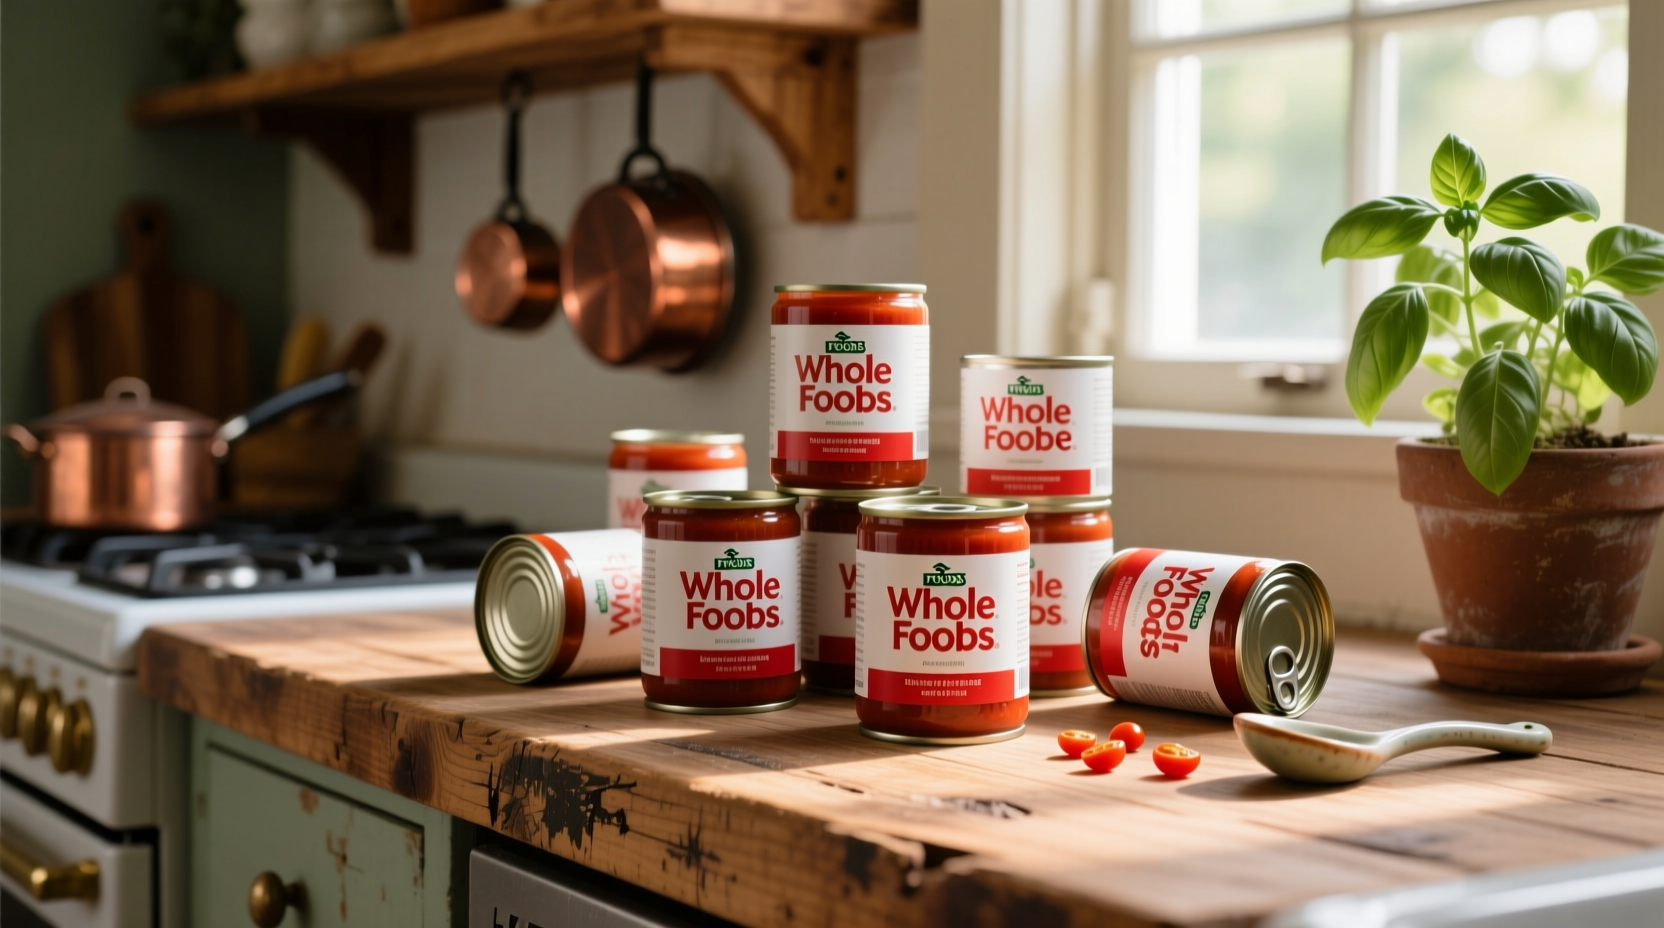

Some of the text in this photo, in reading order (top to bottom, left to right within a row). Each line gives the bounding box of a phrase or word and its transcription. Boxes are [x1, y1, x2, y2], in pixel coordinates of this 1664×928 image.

[794, 353, 893, 384] Whole
[799, 384, 893, 413] Foobs
[980, 395, 1072, 424] Whole
[984, 425, 1073, 451] Foobe
[679, 569, 780, 601] Whole
[686, 602, 780, 630] Foobs
[886, 585, 996, 620] Whole
[892, 620, 996, 651] Foobs
